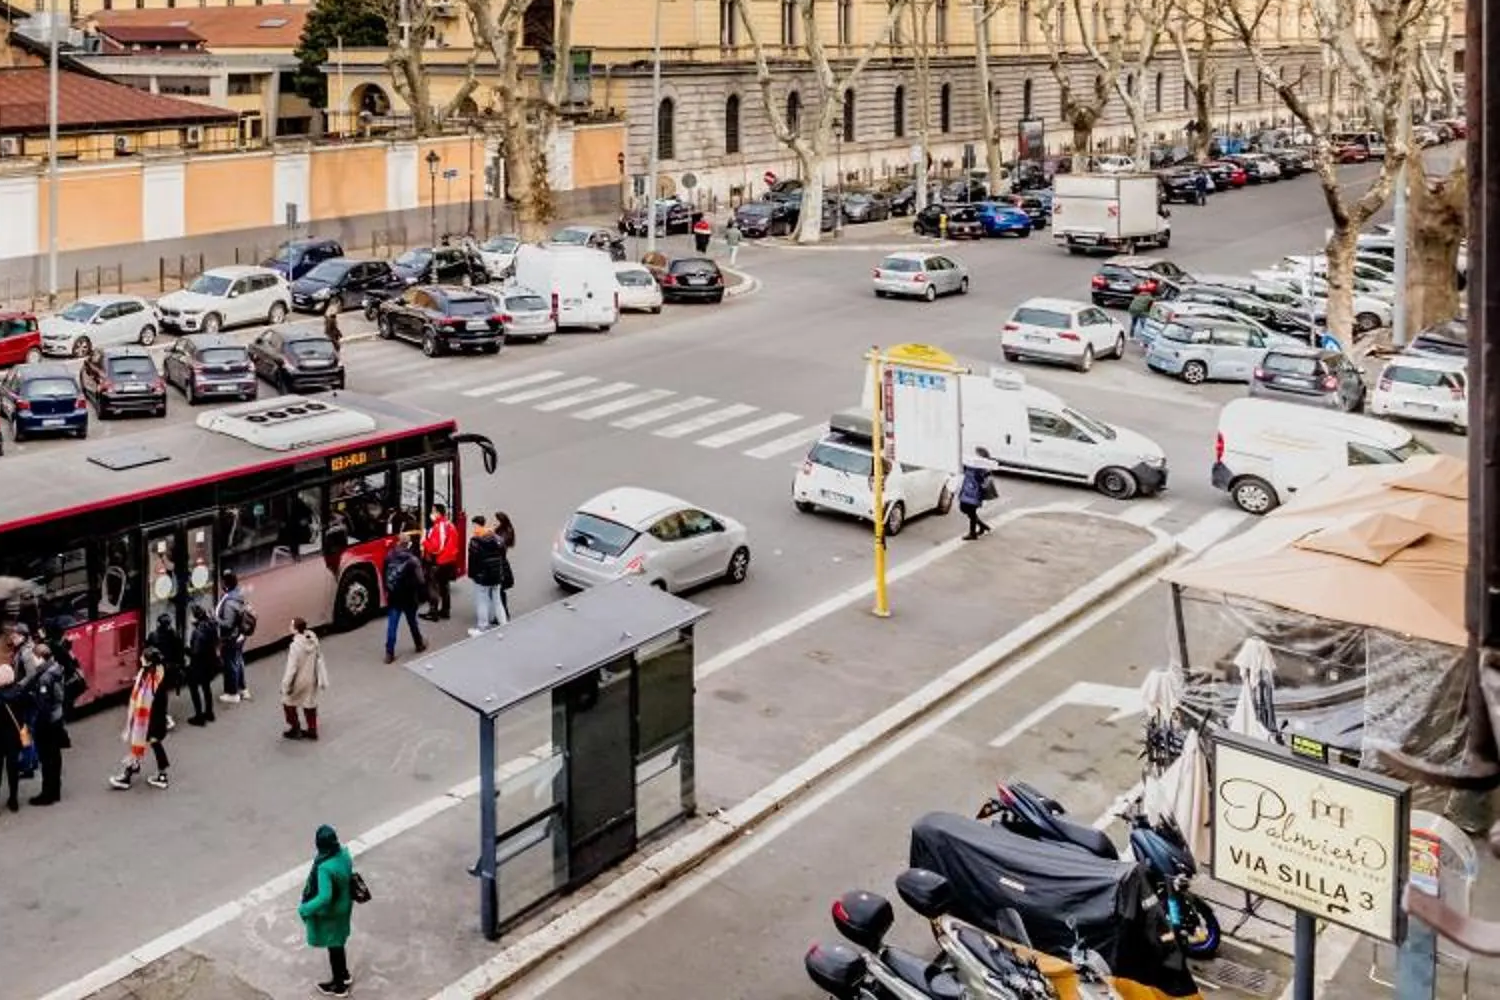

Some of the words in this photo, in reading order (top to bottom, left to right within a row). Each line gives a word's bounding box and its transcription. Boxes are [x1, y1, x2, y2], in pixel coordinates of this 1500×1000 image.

[1219, 777, 1387, 871] Palmieri
[1230, 846, 1268, 875] VIA
[1278, 863, 1349, 903] SILLA
[1359, 891, 1375, 911] 3
